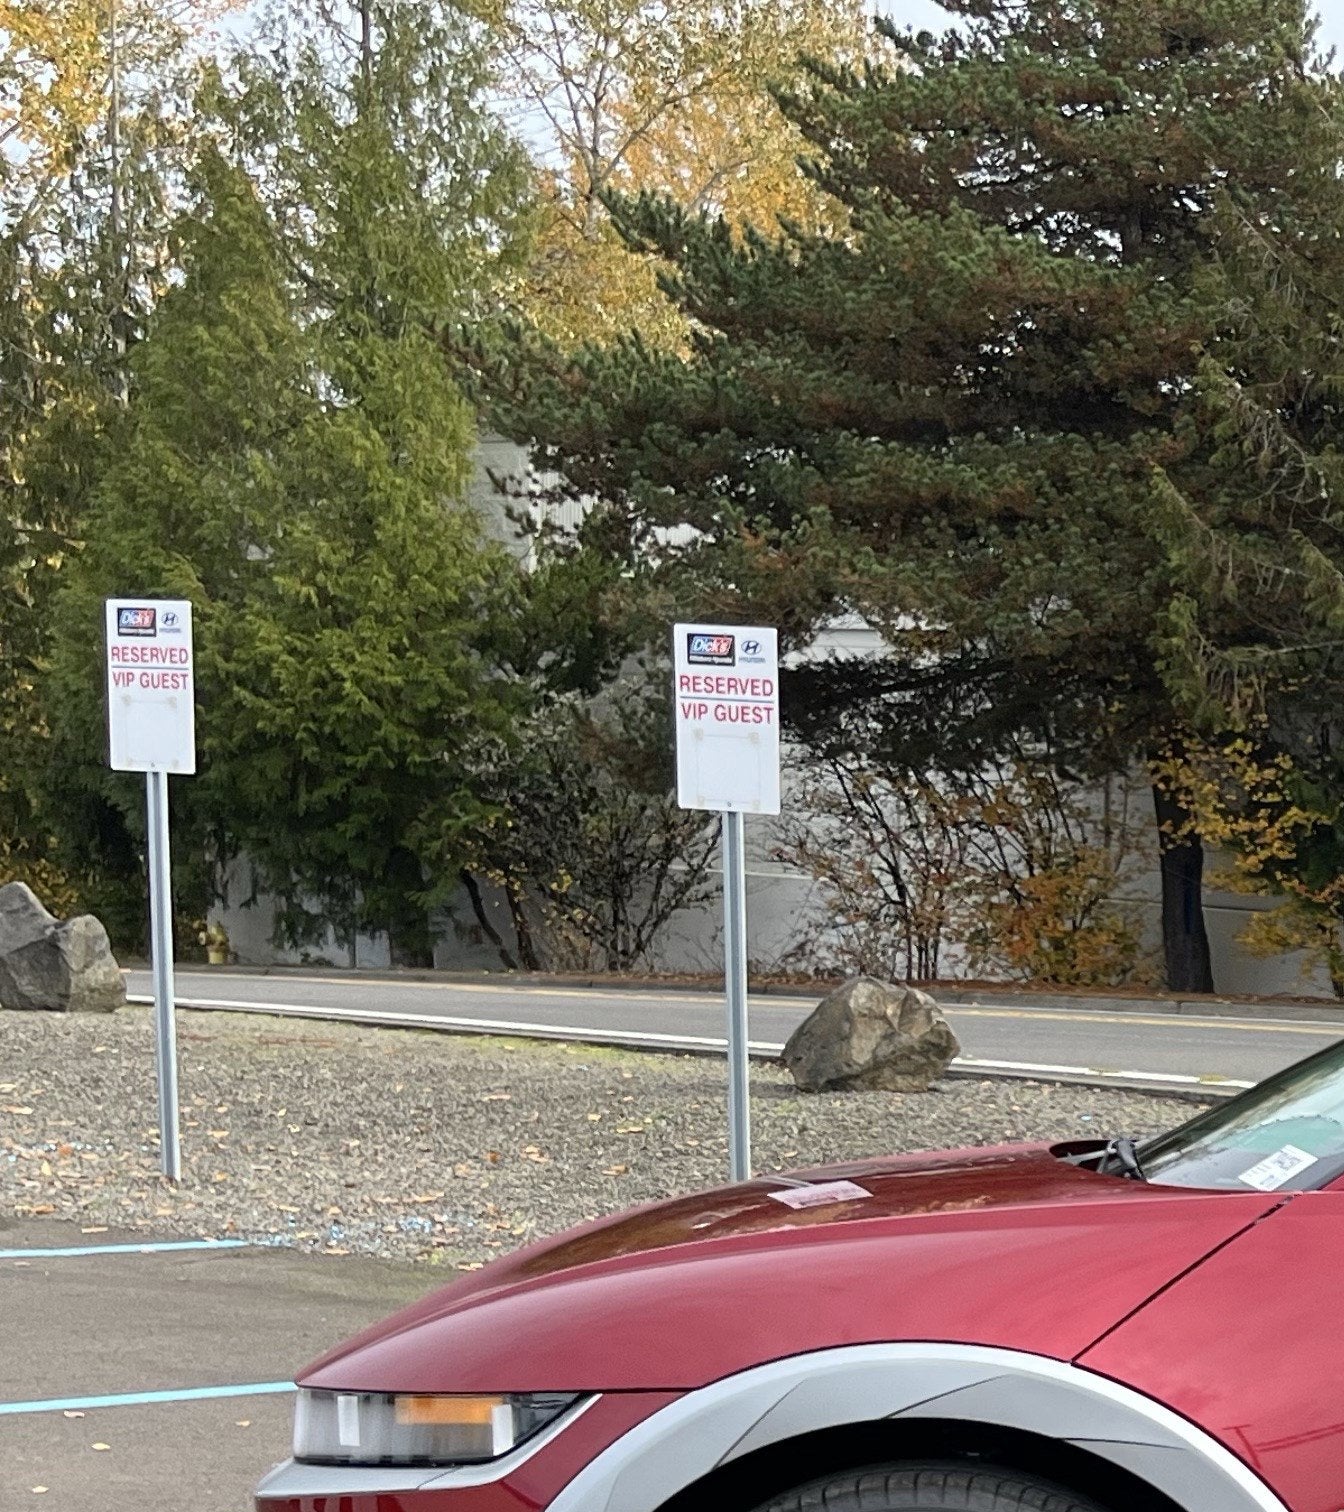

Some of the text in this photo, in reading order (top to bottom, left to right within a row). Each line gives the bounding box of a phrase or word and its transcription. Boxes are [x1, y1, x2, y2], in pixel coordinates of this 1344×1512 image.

[111, 646, 189, 664] RESERVED
[112, 671, 189, 690] VIP GUEST
[680, 675, 774, 696] RESERVED
[681, 703, 774, 725] VIP GUEST
